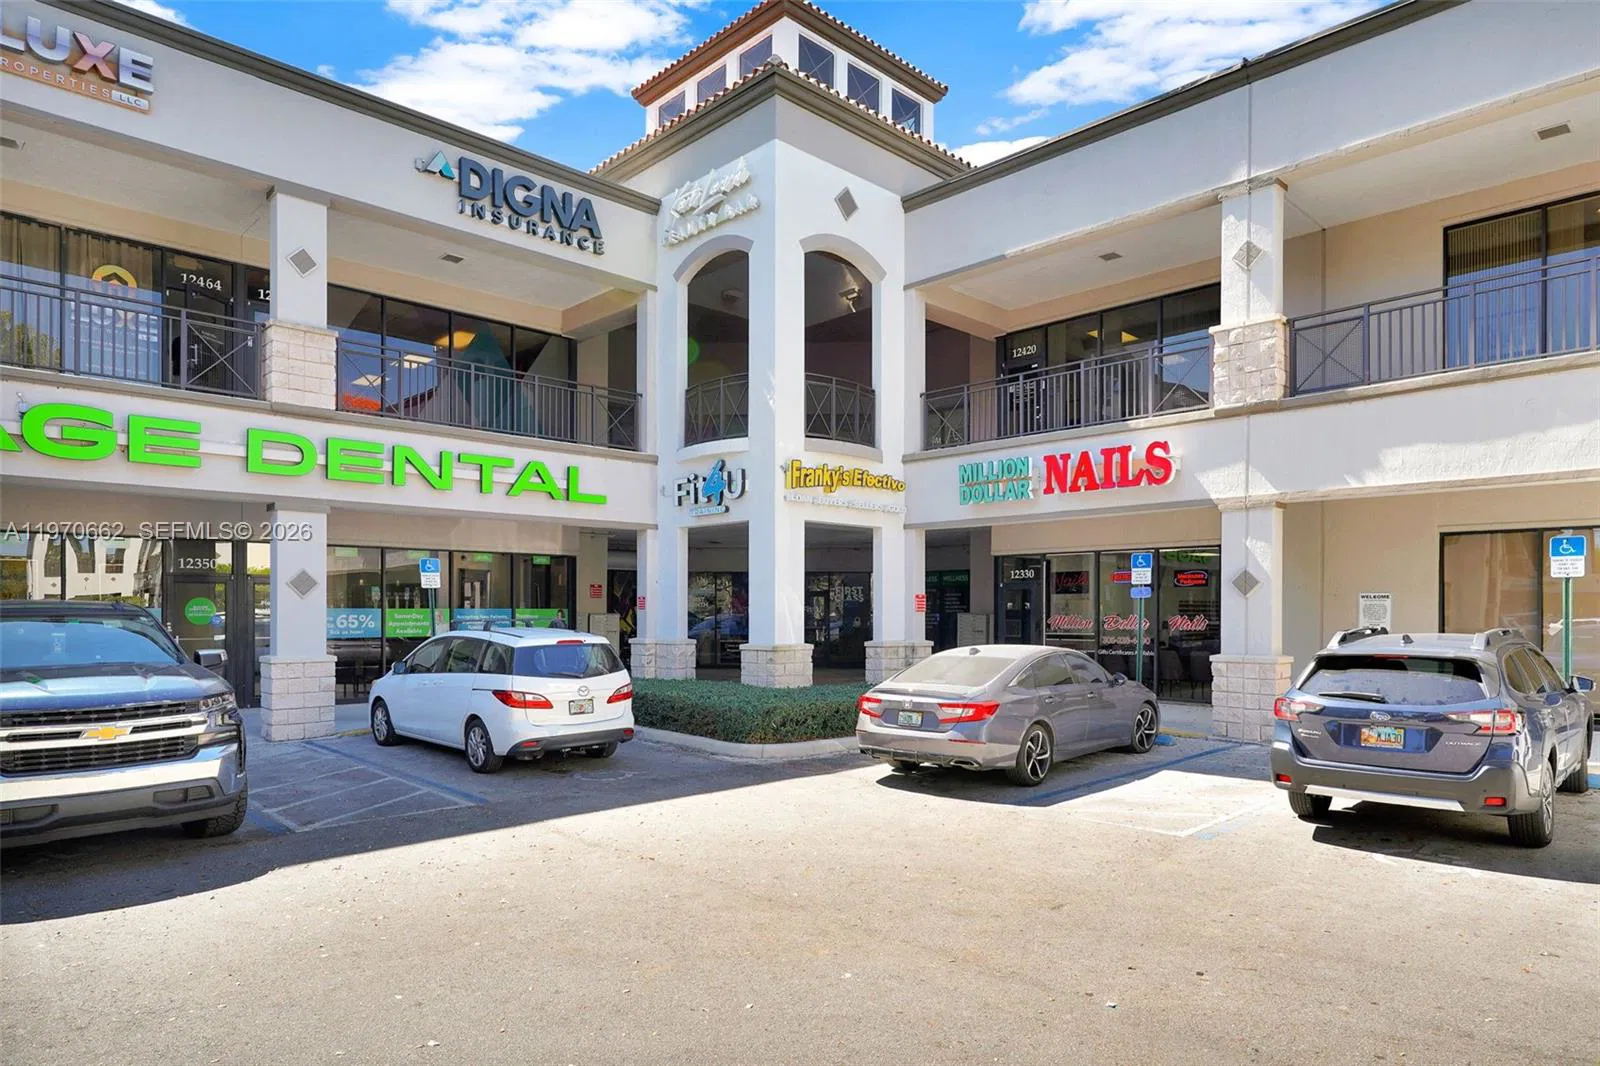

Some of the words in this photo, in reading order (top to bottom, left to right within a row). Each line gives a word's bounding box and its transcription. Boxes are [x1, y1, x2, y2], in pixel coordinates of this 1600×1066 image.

[118, 93, 144, 107] LLC
[459, 156, 603, 239] DIGNA
[456, 199, 605, 255] INSURANCE
[180, 273, 222, 291] 12464
[1012, 344, 1037, 358] 12420
[247, 428, 607, 504] DENTAL
[790, 459, 850, 494] Franky's
[852, 468, 906, 492] Efectivo
[959, 457, 1031, 483] MILLION
[1043, 441, 1173, 494] NAILS
[959, 480, 1032, 505] DOLLAR
[177, 557, 217, 569] 12350
[1010, 568, 1035, 579] 12330
[336, 614, 375, 628] 65%
